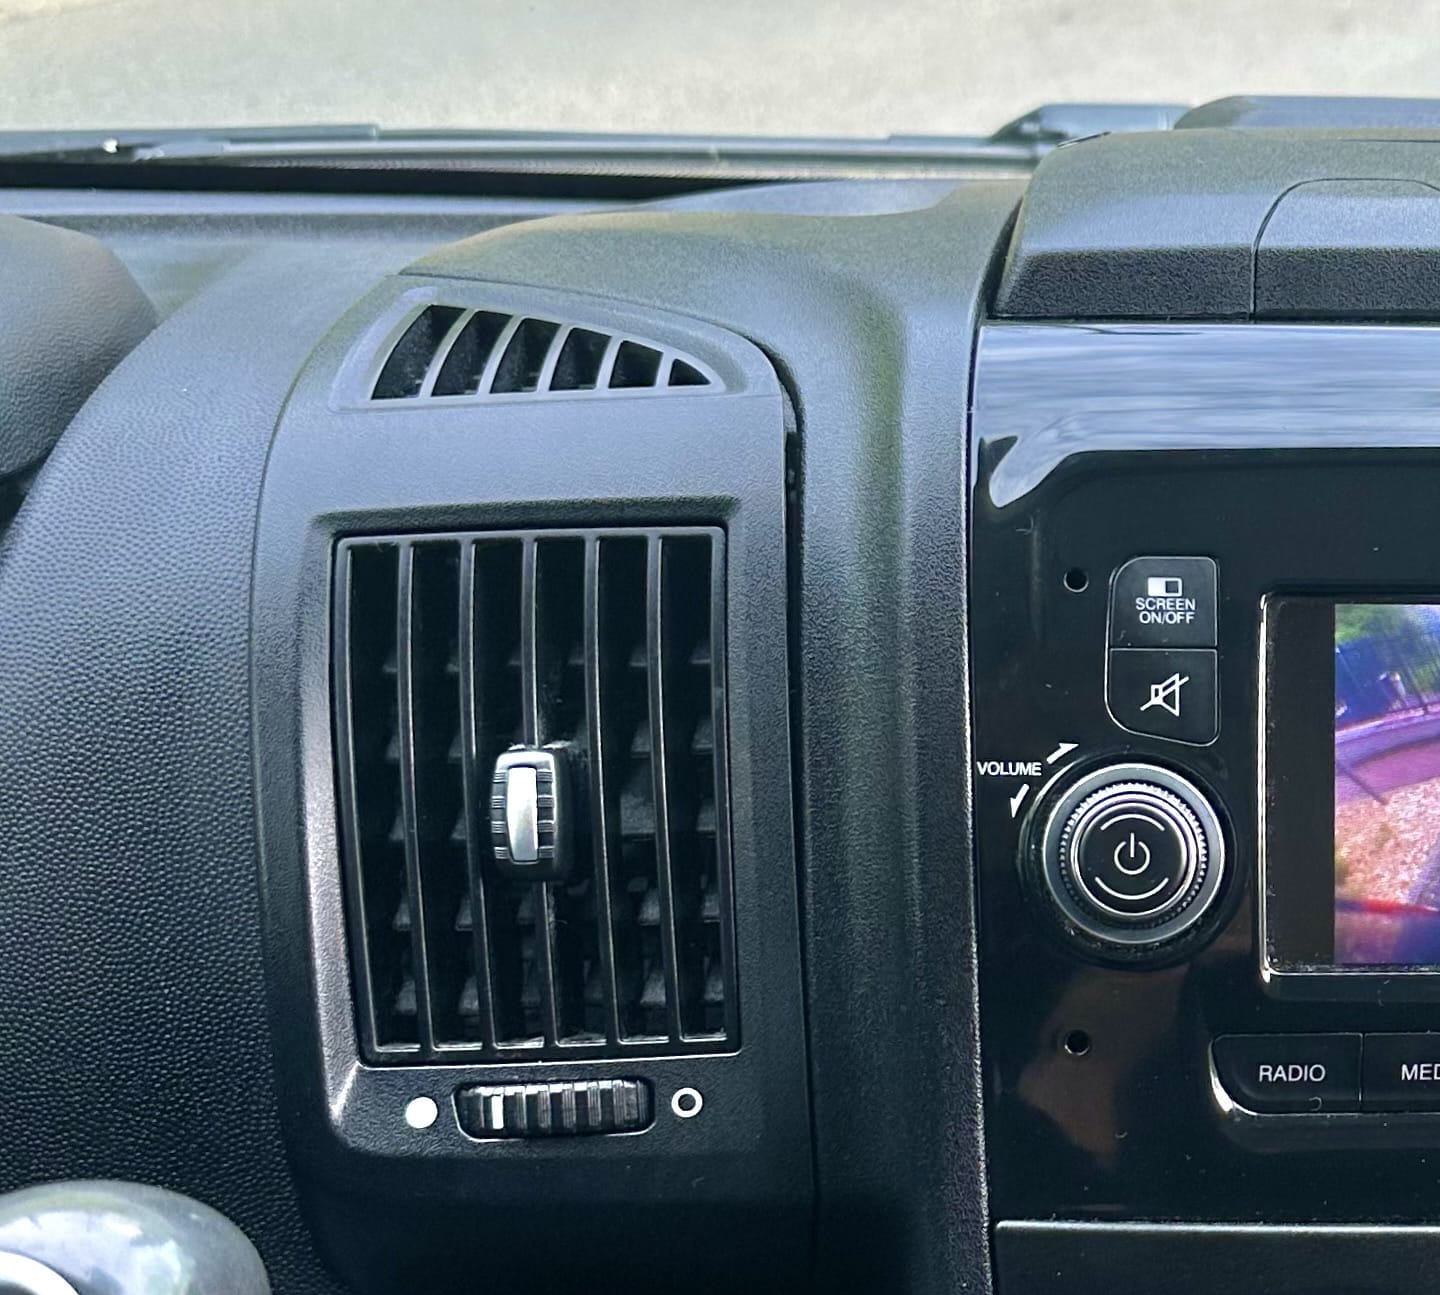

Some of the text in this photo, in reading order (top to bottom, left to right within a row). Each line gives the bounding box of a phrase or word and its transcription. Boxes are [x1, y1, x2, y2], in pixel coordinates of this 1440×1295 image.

[1135, 598, 1196, 611] SCREEN
[1138, 611, 1195, 625] ON/OFF
[976, 761, 1043, 777] VOLUME
[1258, 1064, 1326, 1082] RADIO
